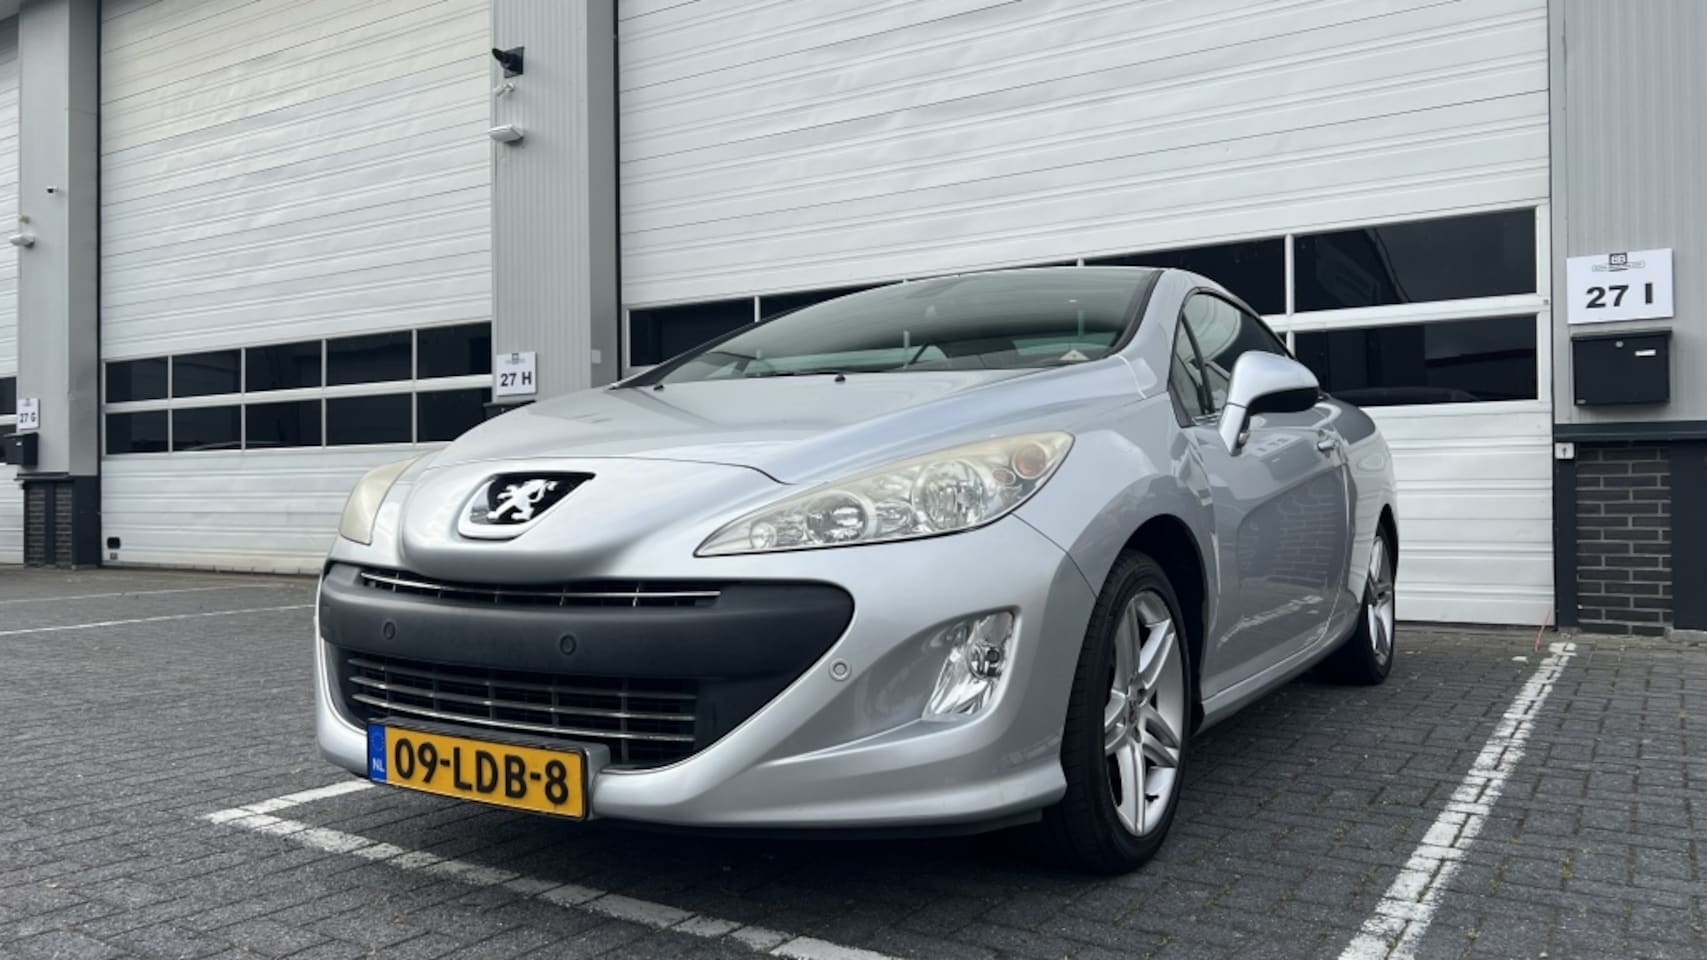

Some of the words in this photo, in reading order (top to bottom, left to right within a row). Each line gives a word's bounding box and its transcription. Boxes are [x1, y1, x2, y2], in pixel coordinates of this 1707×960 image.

[1586, 285, 1629, 309] 27
[1645, 282, 1653, 305] I
[500, 372, 517, 387] 27
[522, 371, 532, 386] H
[20, 412, 29, 424] 27
[372, 757, 385, 773] NL
[394, 737, 569, 805] 09-LDB-8
